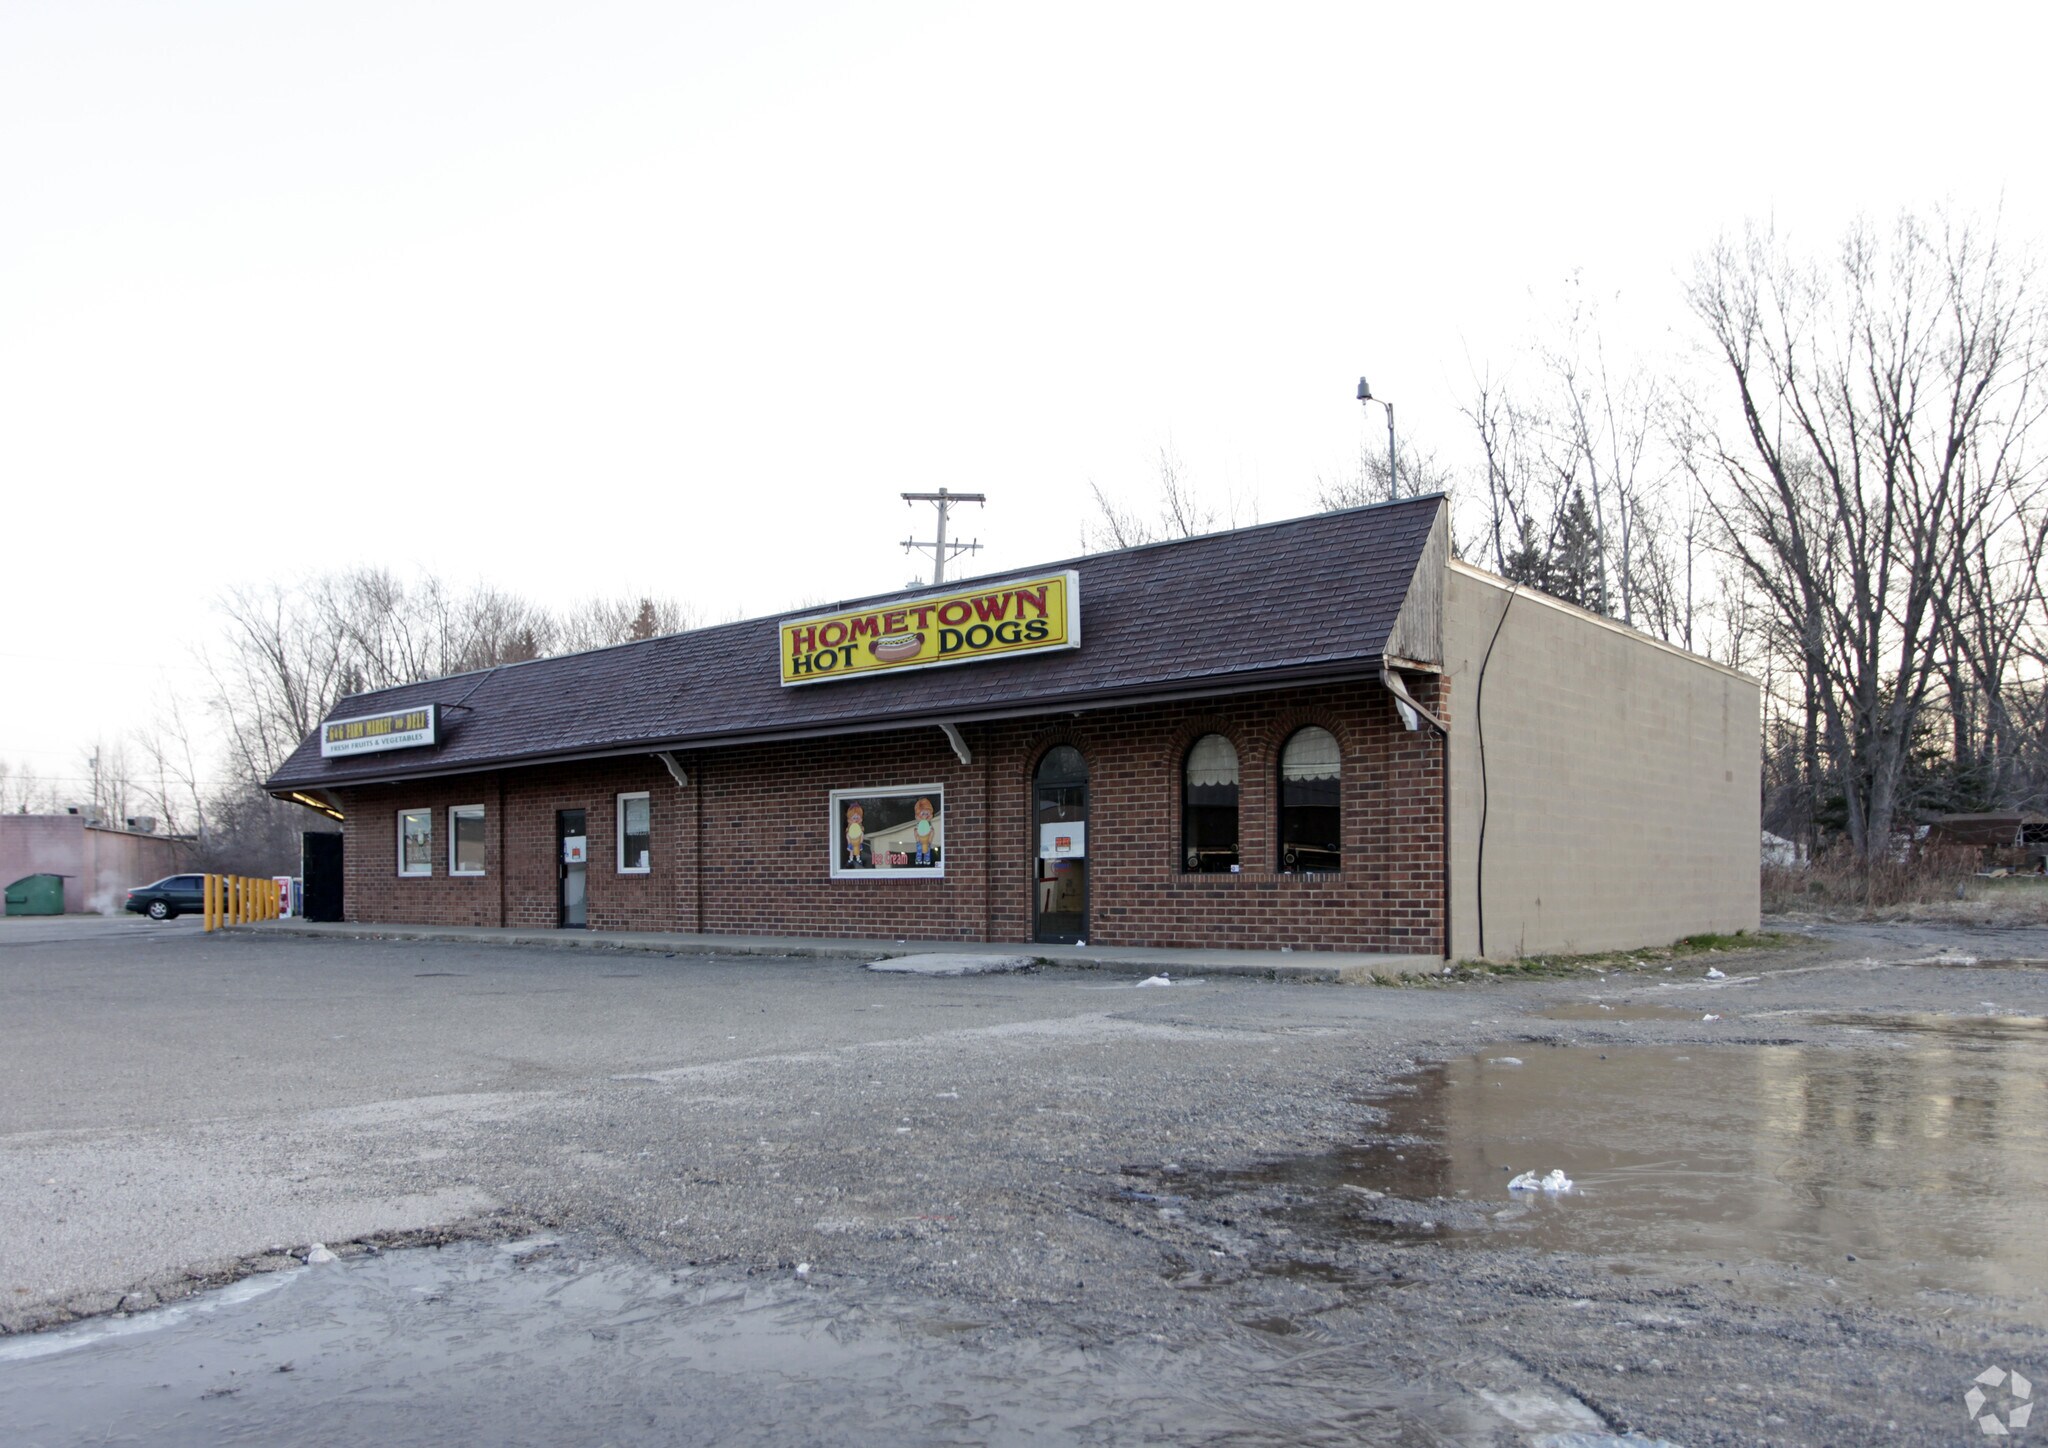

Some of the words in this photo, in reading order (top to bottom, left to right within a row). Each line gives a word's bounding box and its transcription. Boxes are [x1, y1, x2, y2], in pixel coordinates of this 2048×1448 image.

[791, 586, 1049, 657] HOMETOWN
[791, 643, 859, 675] HOT
[938, 619, 1049, 654] DOGS
[366, 717, 392, 736] MARKET
[406, 712, 425, 730] DELI
[331, 743, 350, 752] FRESH
[351, 740, 373, 750] FRUITS
[381, 733, 423, 745] VEGETABLES
[871, 851, 883, 865] Ice
[885, 850, 908, 865] Cream
